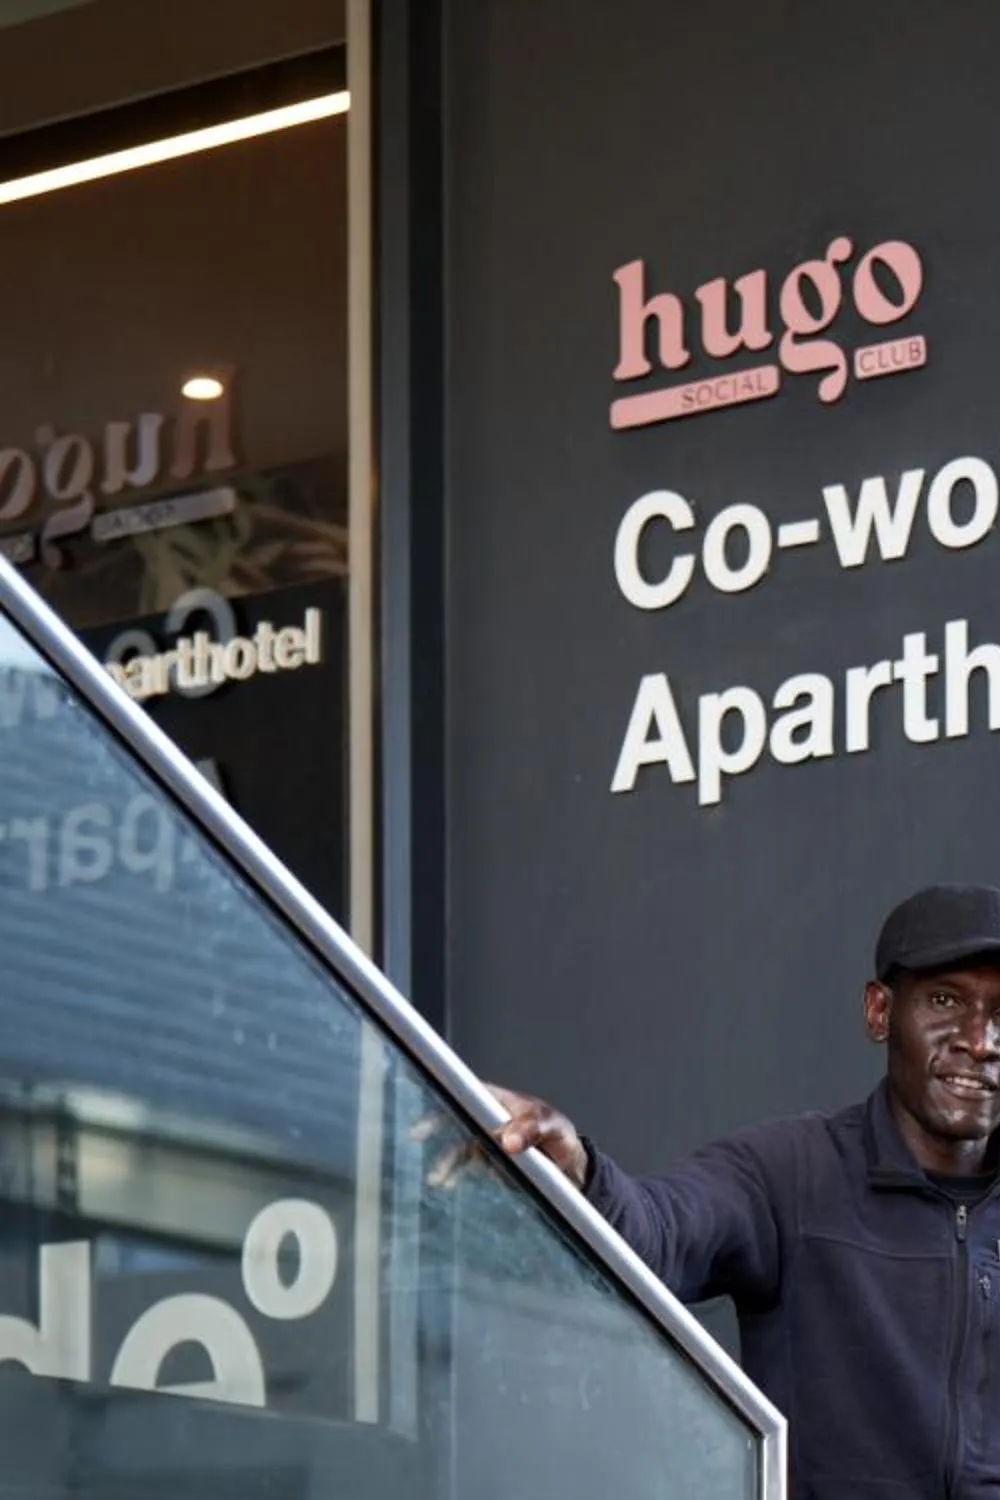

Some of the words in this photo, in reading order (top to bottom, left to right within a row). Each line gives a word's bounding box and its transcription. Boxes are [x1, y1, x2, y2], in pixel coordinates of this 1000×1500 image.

[612, 236, 923, 403] hugo
[680, 372, 767, 410] SOCIAL
[859, 336, 923, 373] CLUB
